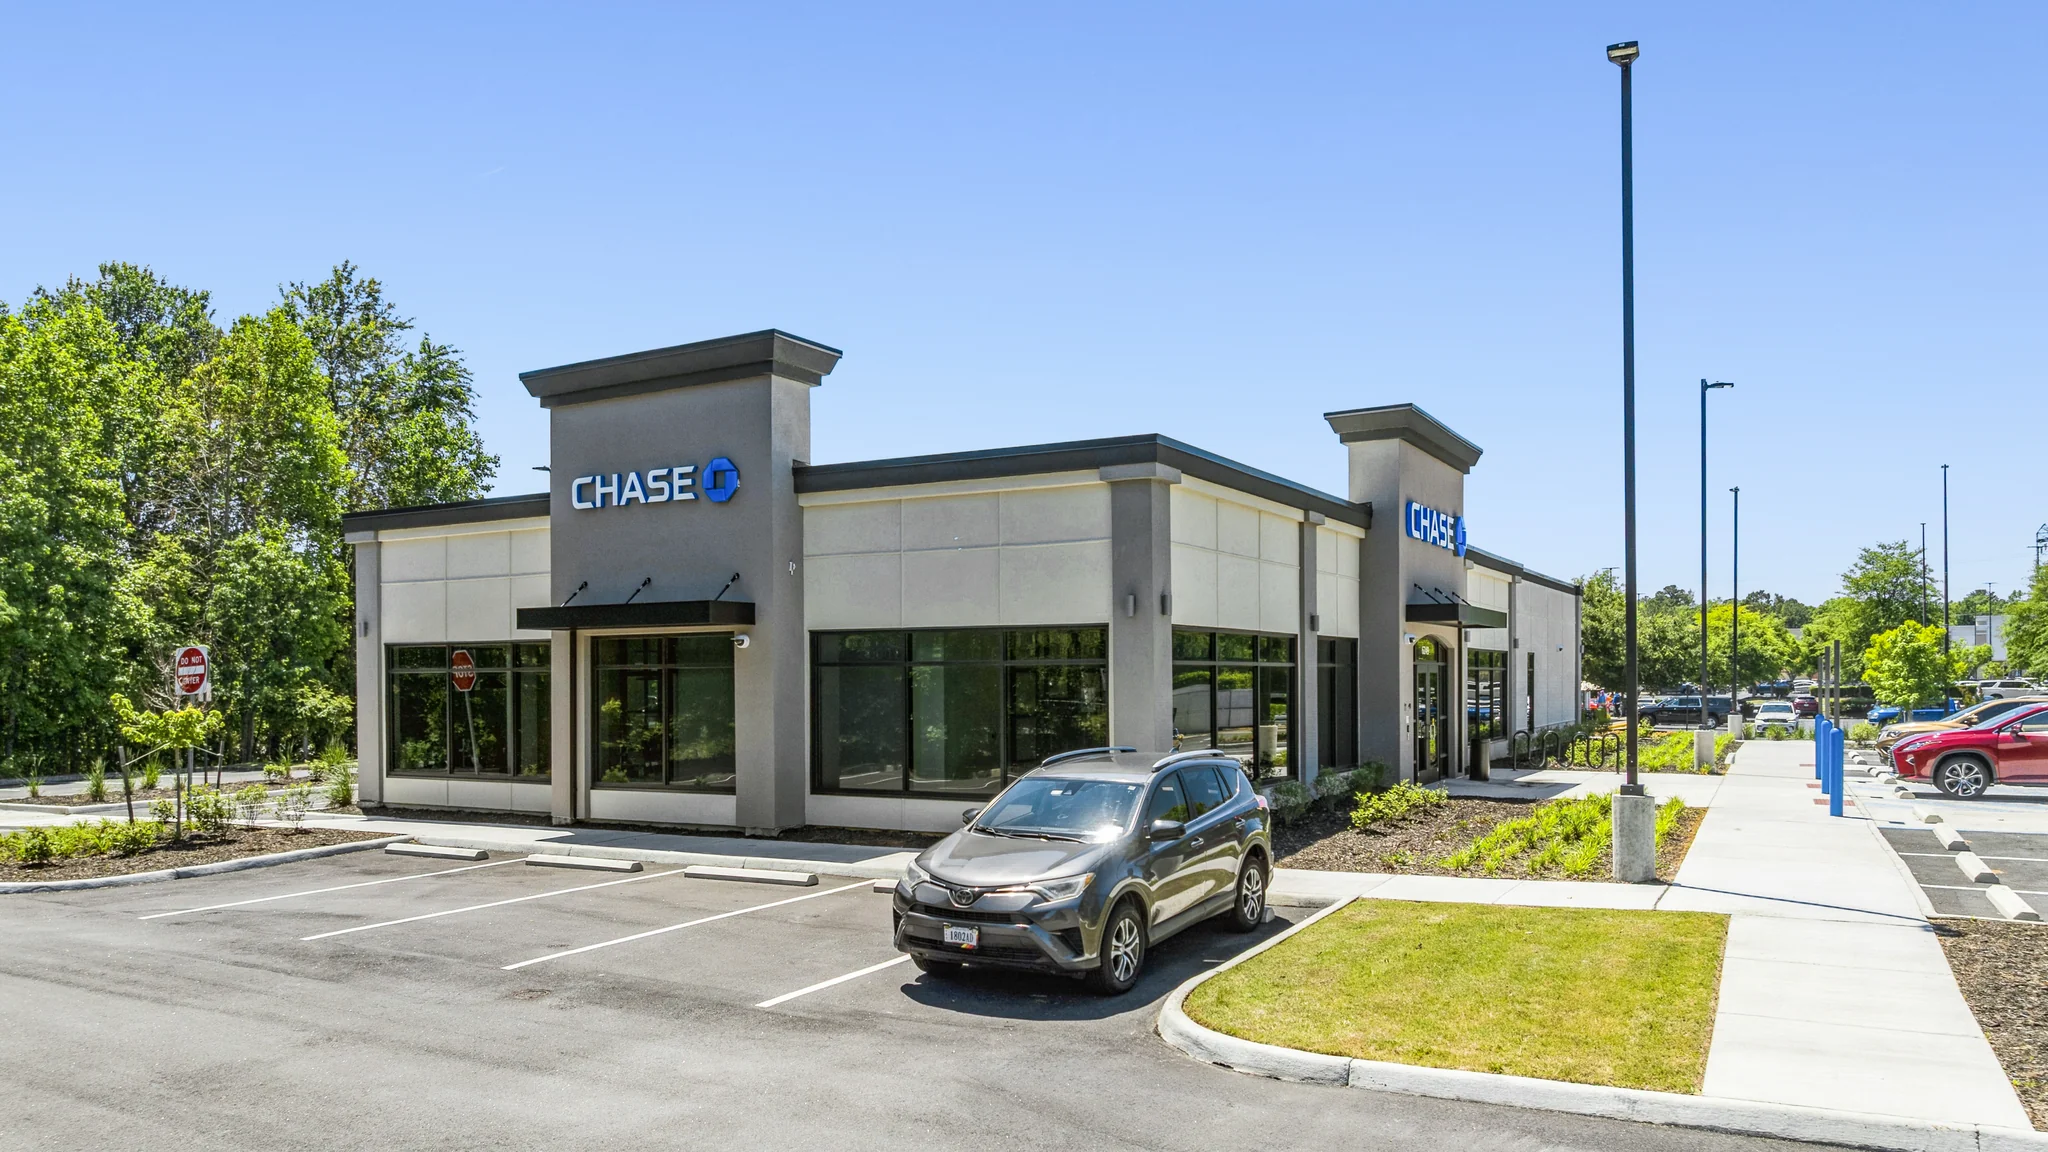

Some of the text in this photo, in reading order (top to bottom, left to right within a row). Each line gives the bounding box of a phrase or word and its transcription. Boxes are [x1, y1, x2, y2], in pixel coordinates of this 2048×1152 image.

[571, 465, 697, 510] CHASE
[1408, 501, 1454, 550] CHASE
[180, 656, 203, 665] DO NOT
